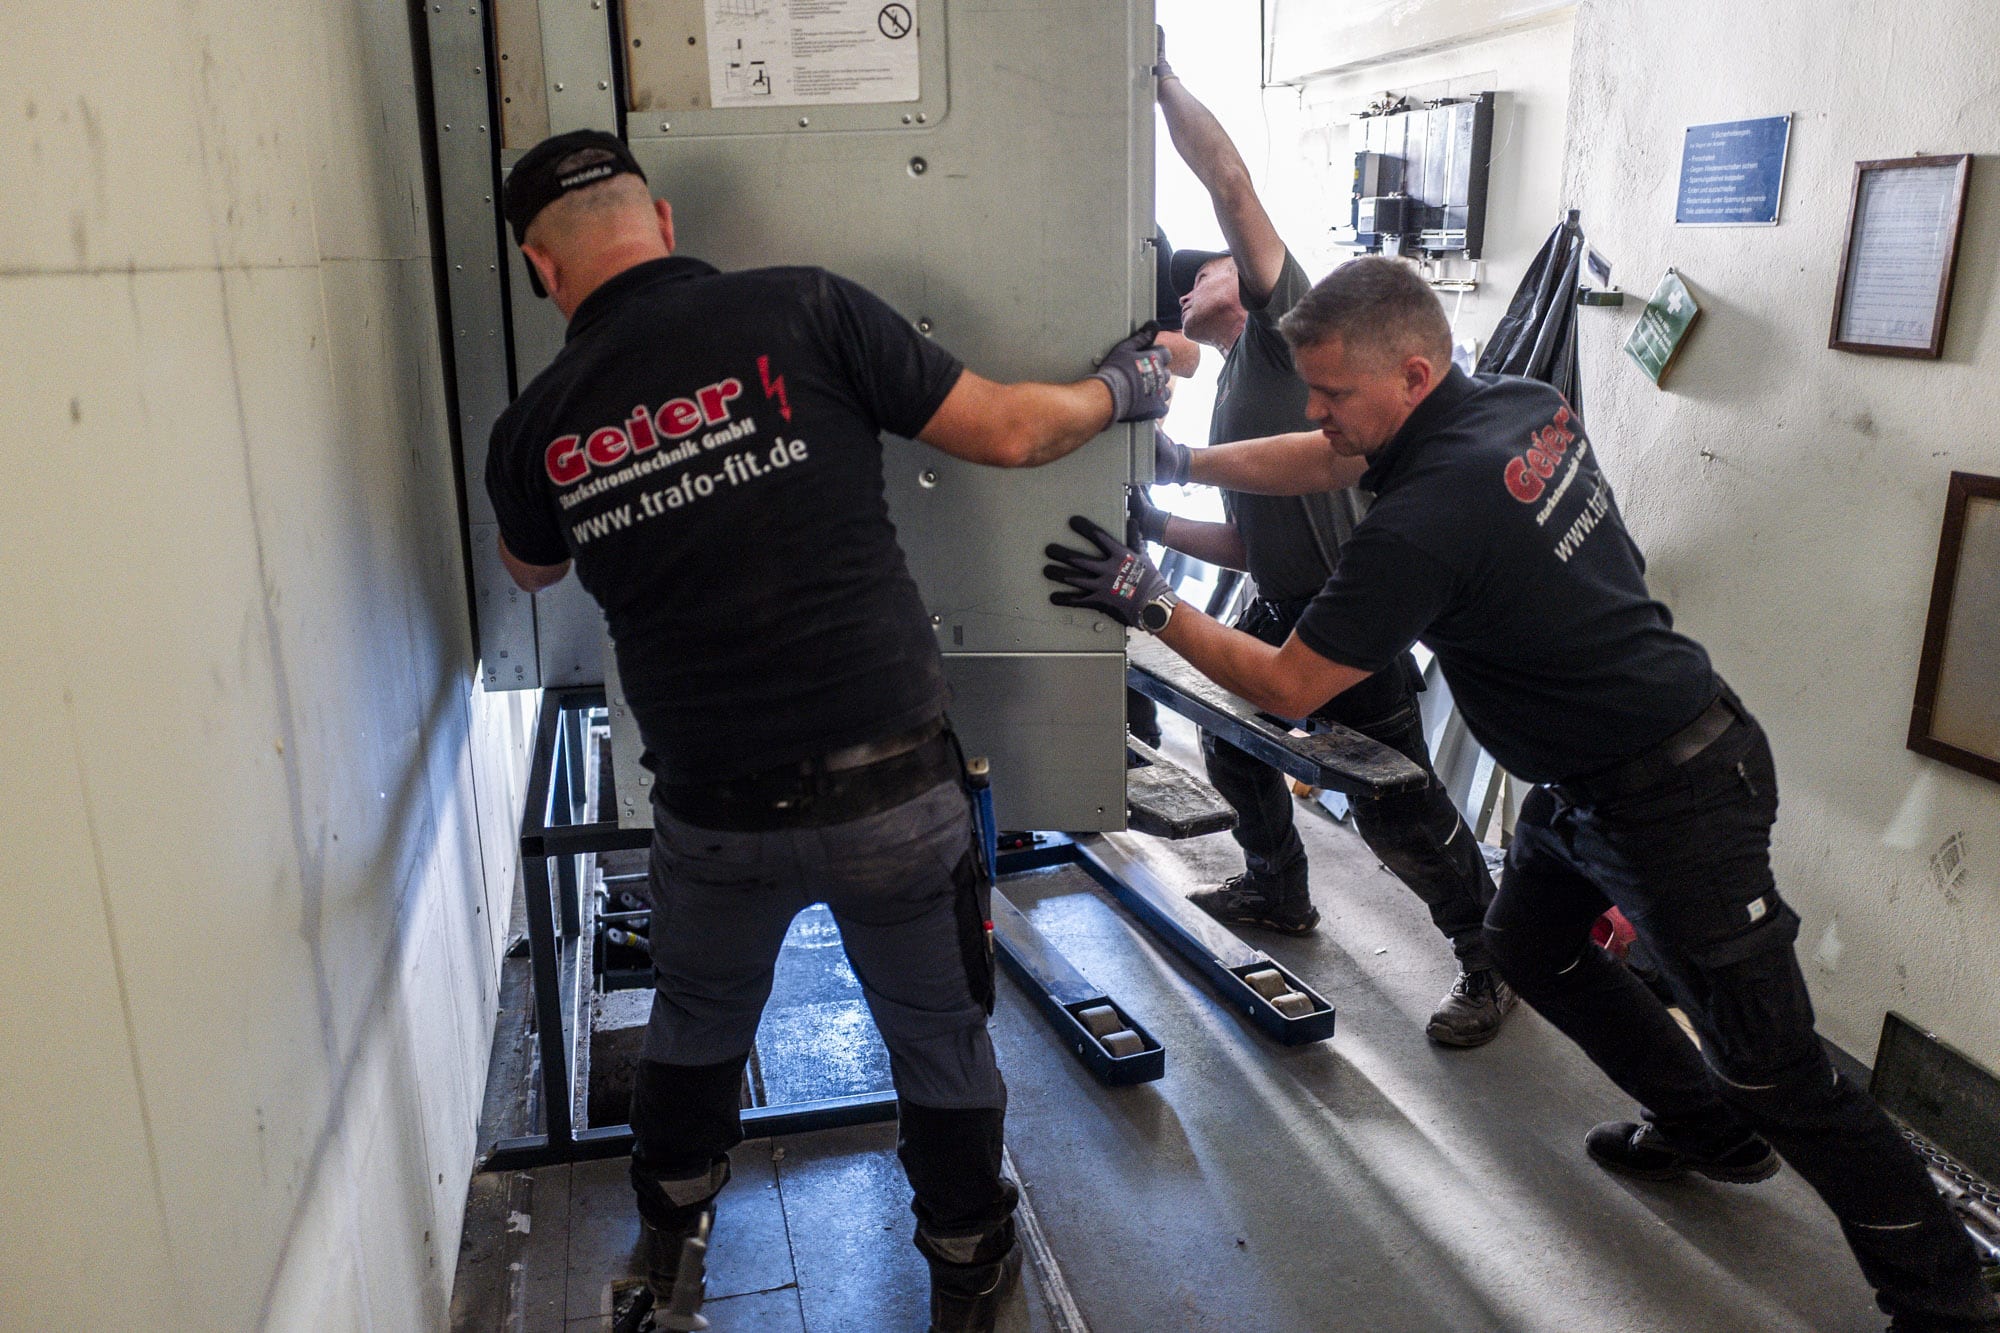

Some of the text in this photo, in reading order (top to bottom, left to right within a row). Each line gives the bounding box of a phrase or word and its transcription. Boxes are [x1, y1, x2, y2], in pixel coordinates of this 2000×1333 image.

[545, 377, 743, 486] Geier
[702, 417, 757, 450] GmbH
[1504, 406, 1575, 503] Geier
[572, 436, 809, 545] www.trafo-fit.de
